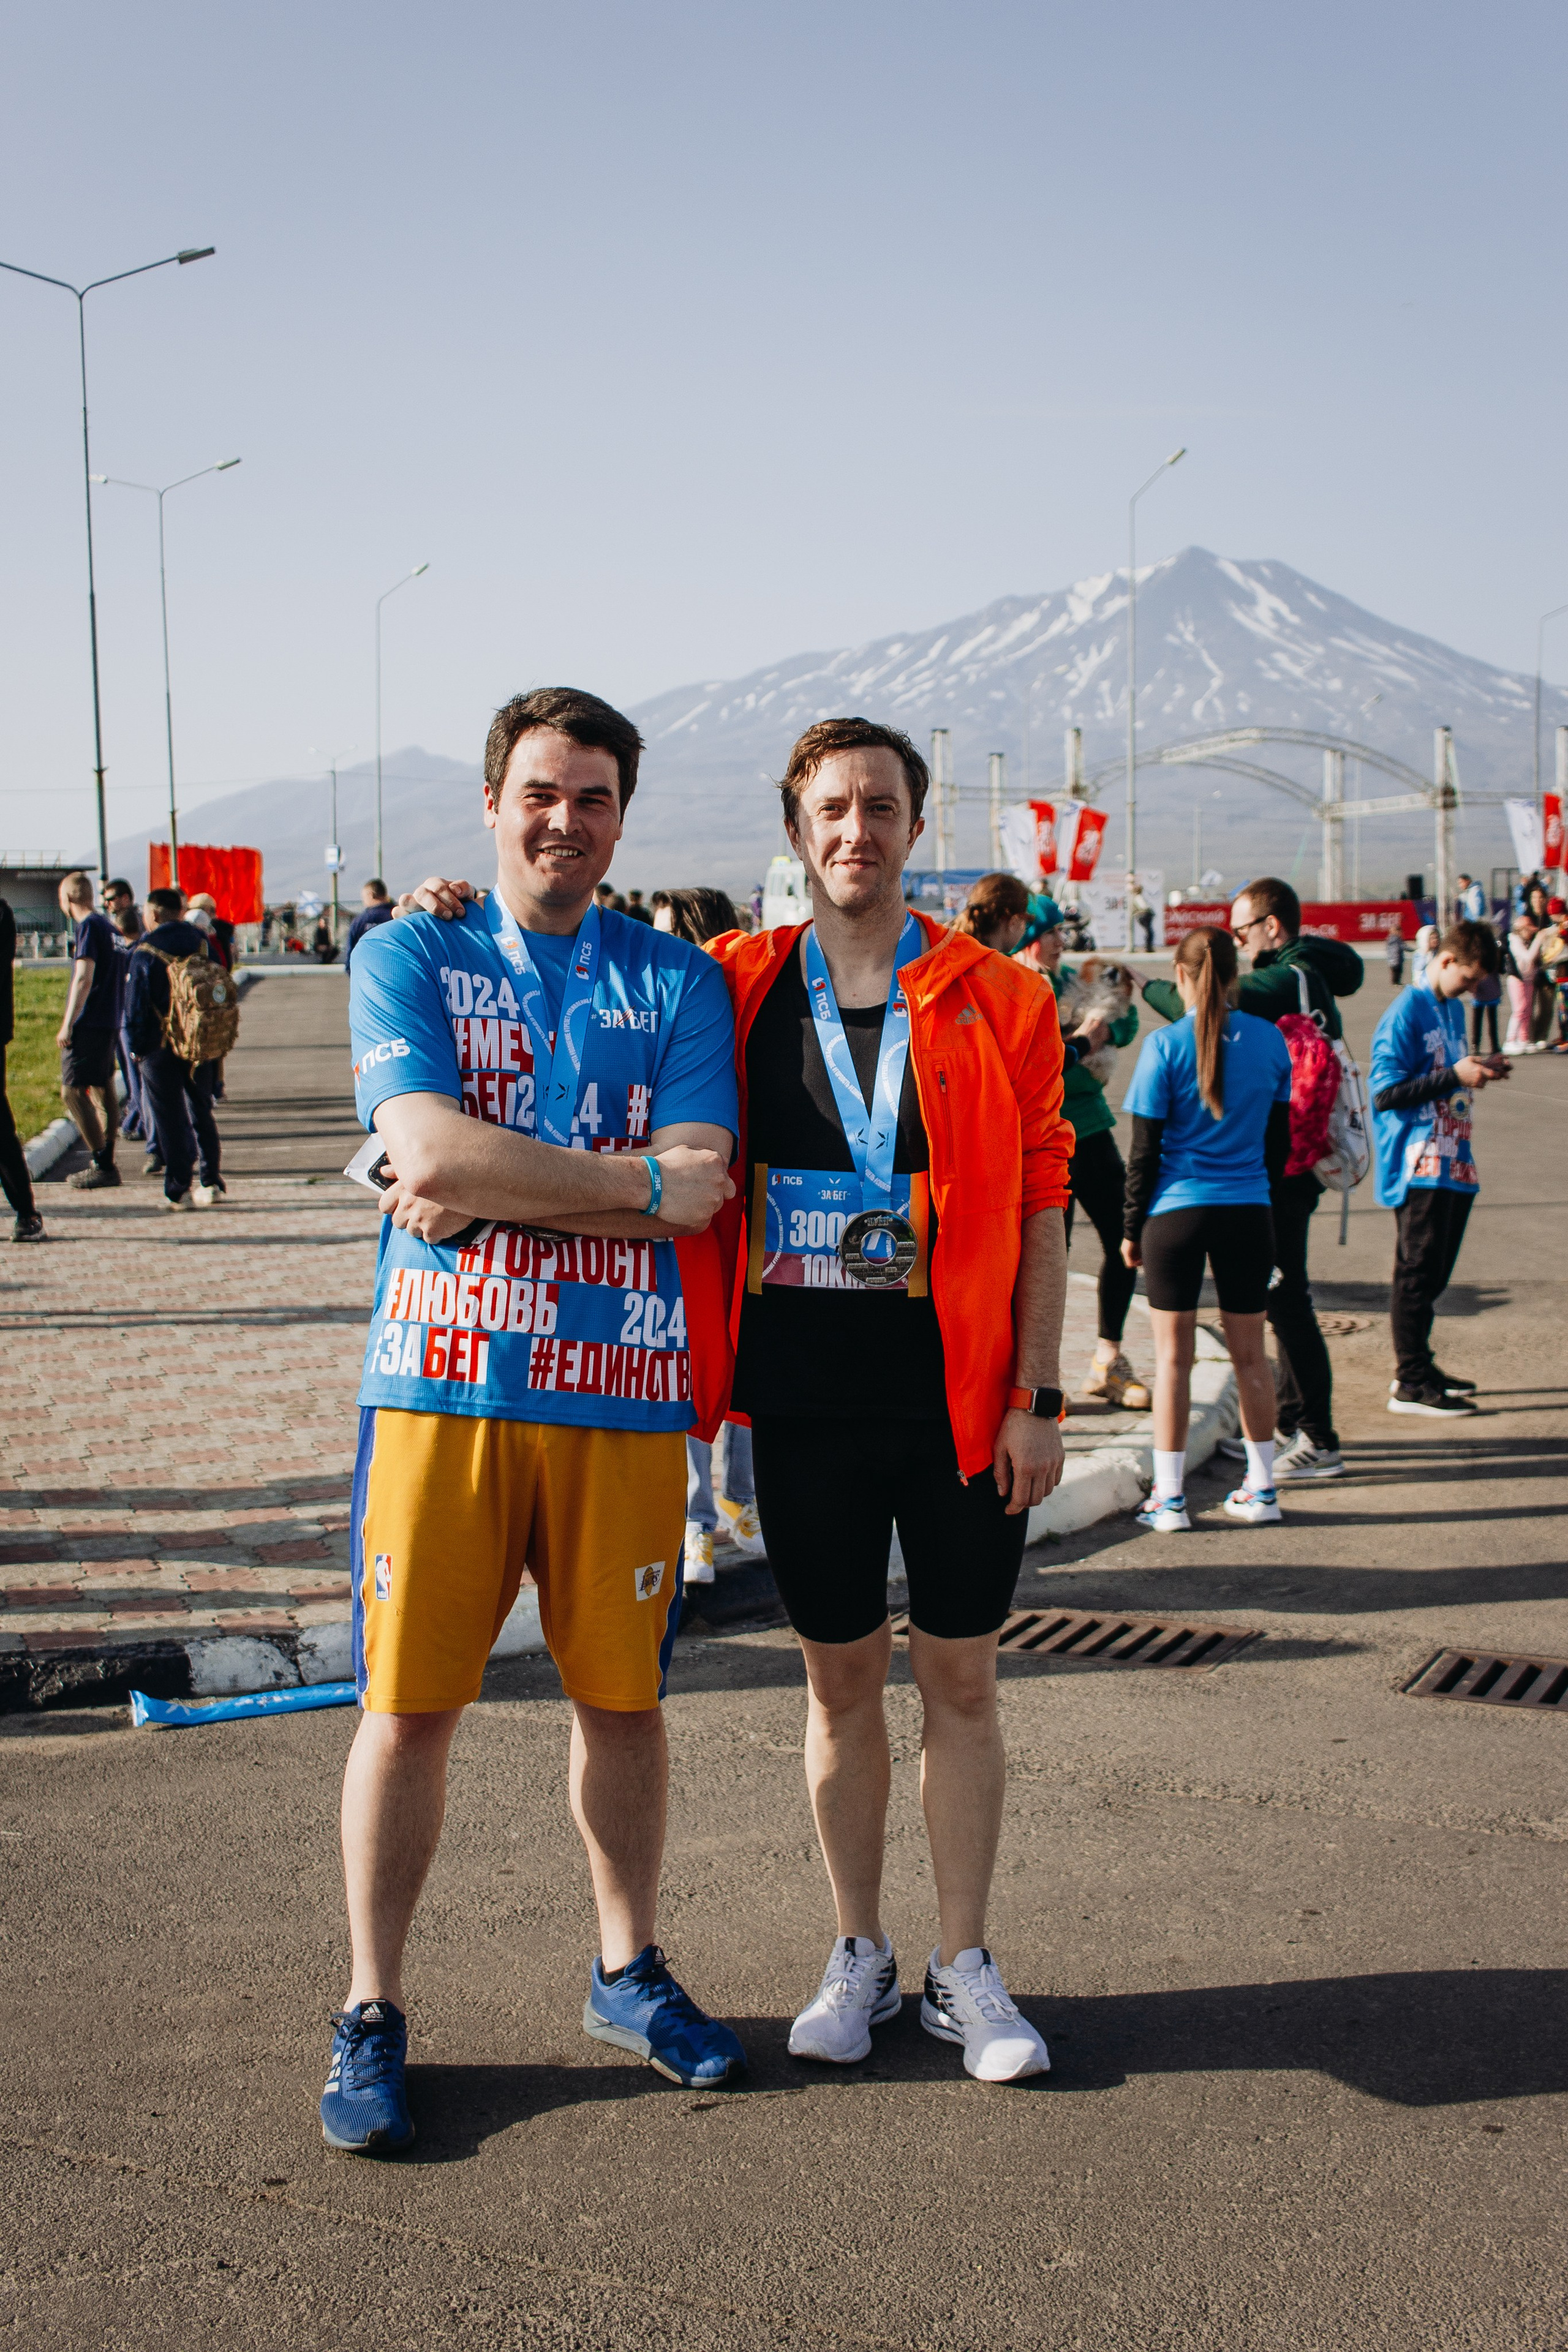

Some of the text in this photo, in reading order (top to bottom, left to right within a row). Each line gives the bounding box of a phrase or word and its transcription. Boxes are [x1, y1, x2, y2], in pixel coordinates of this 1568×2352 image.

[508, 951, 526, 975] ПСБ
[579, 941, 592, 965] ПСБ
[816, 992, 831, 1020] ПСБ
[362, 1038, 410, 1075] ПСБ
[783, 1175, 803, 1185] ПСБ
[383, 1267, 560, 1335] #ЛЮБОВЬ
[528, 1338, 693, 1402] #ЕДИНСТВ
